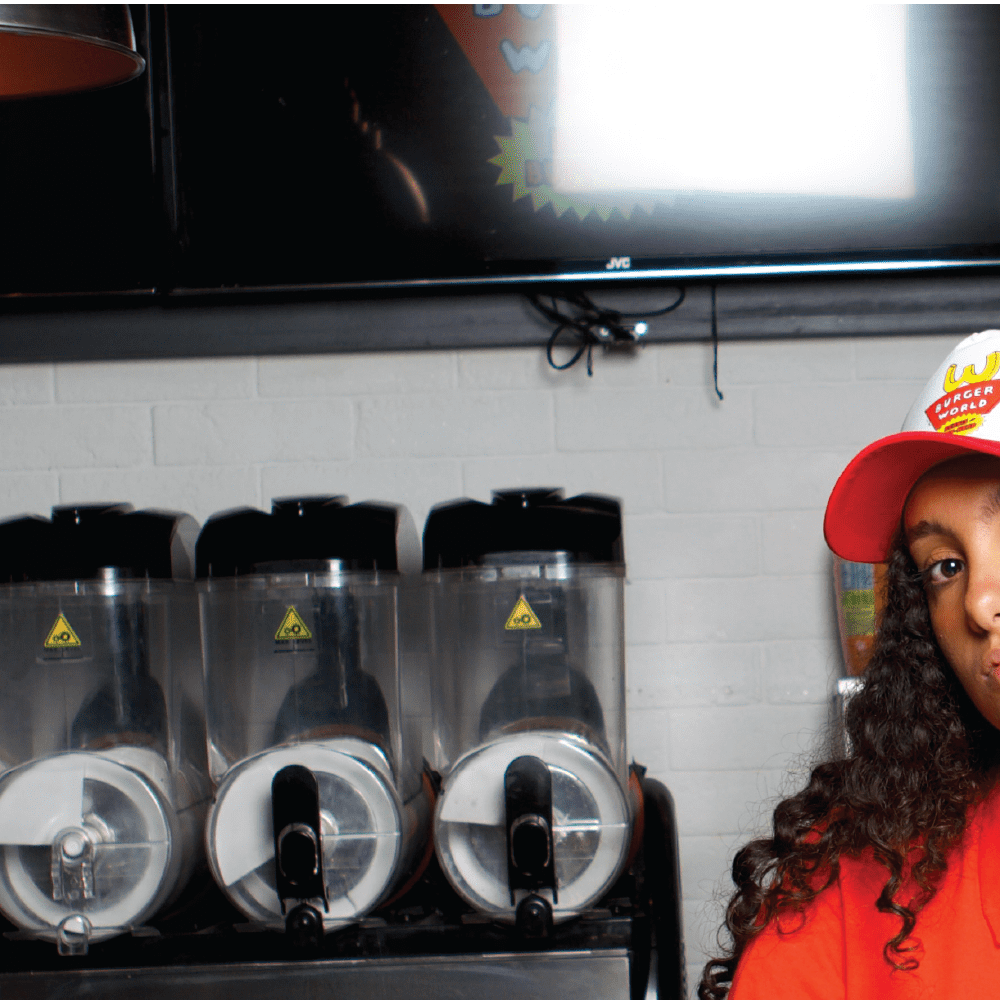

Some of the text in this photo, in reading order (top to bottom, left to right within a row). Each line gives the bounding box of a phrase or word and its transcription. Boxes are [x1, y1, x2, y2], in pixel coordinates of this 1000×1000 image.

[606, 256, 631, 269] JVC
[935, 385, 994, 413] BURGER
[938, 399, 988, 420] WORLD
